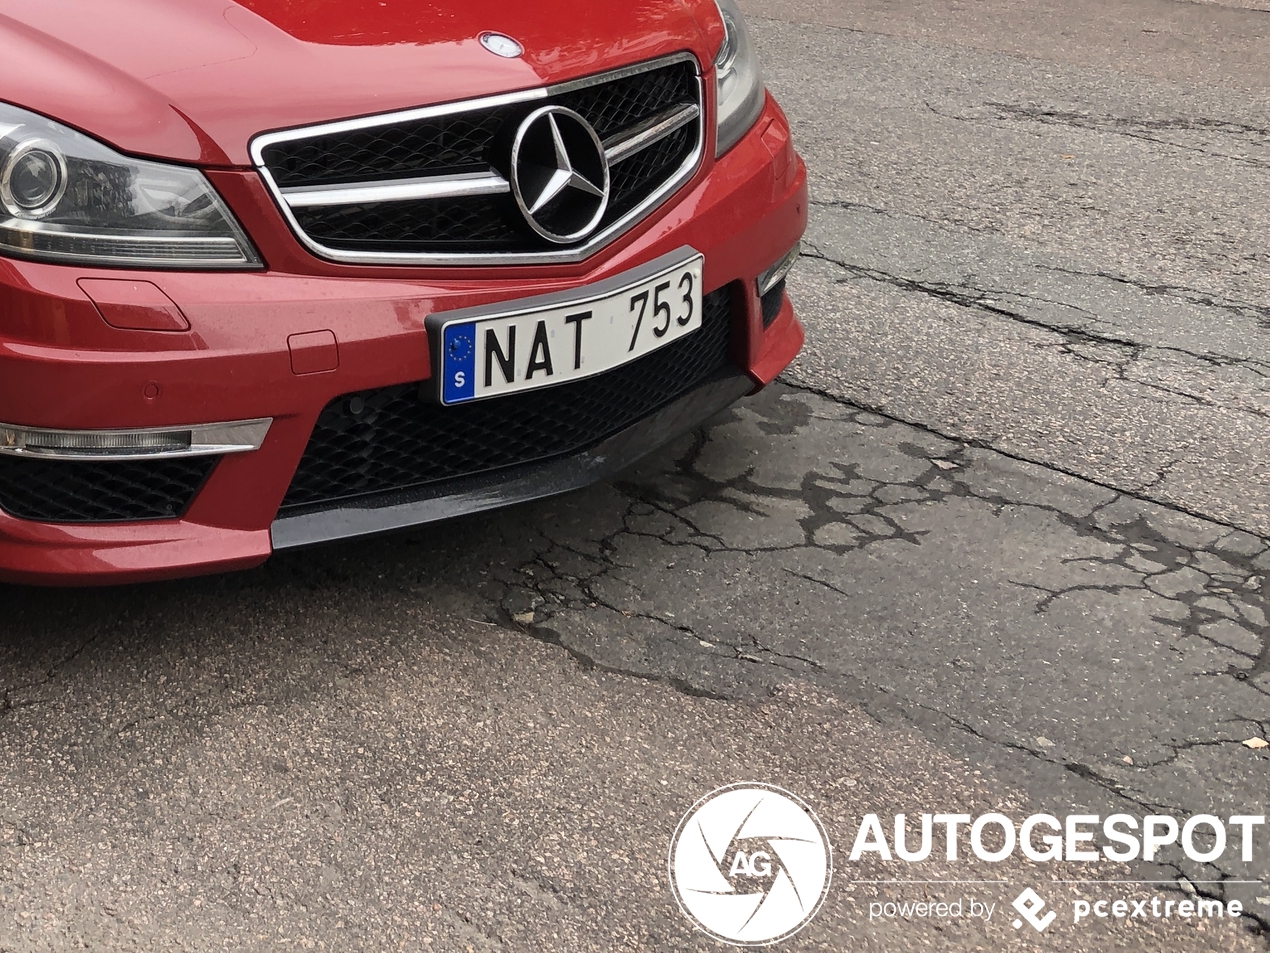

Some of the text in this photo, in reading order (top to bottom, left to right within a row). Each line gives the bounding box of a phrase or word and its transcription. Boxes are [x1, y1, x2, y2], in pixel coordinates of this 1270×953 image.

[483, 271, 694, 388] NAT 753
[454, 371, 465, 388] S
